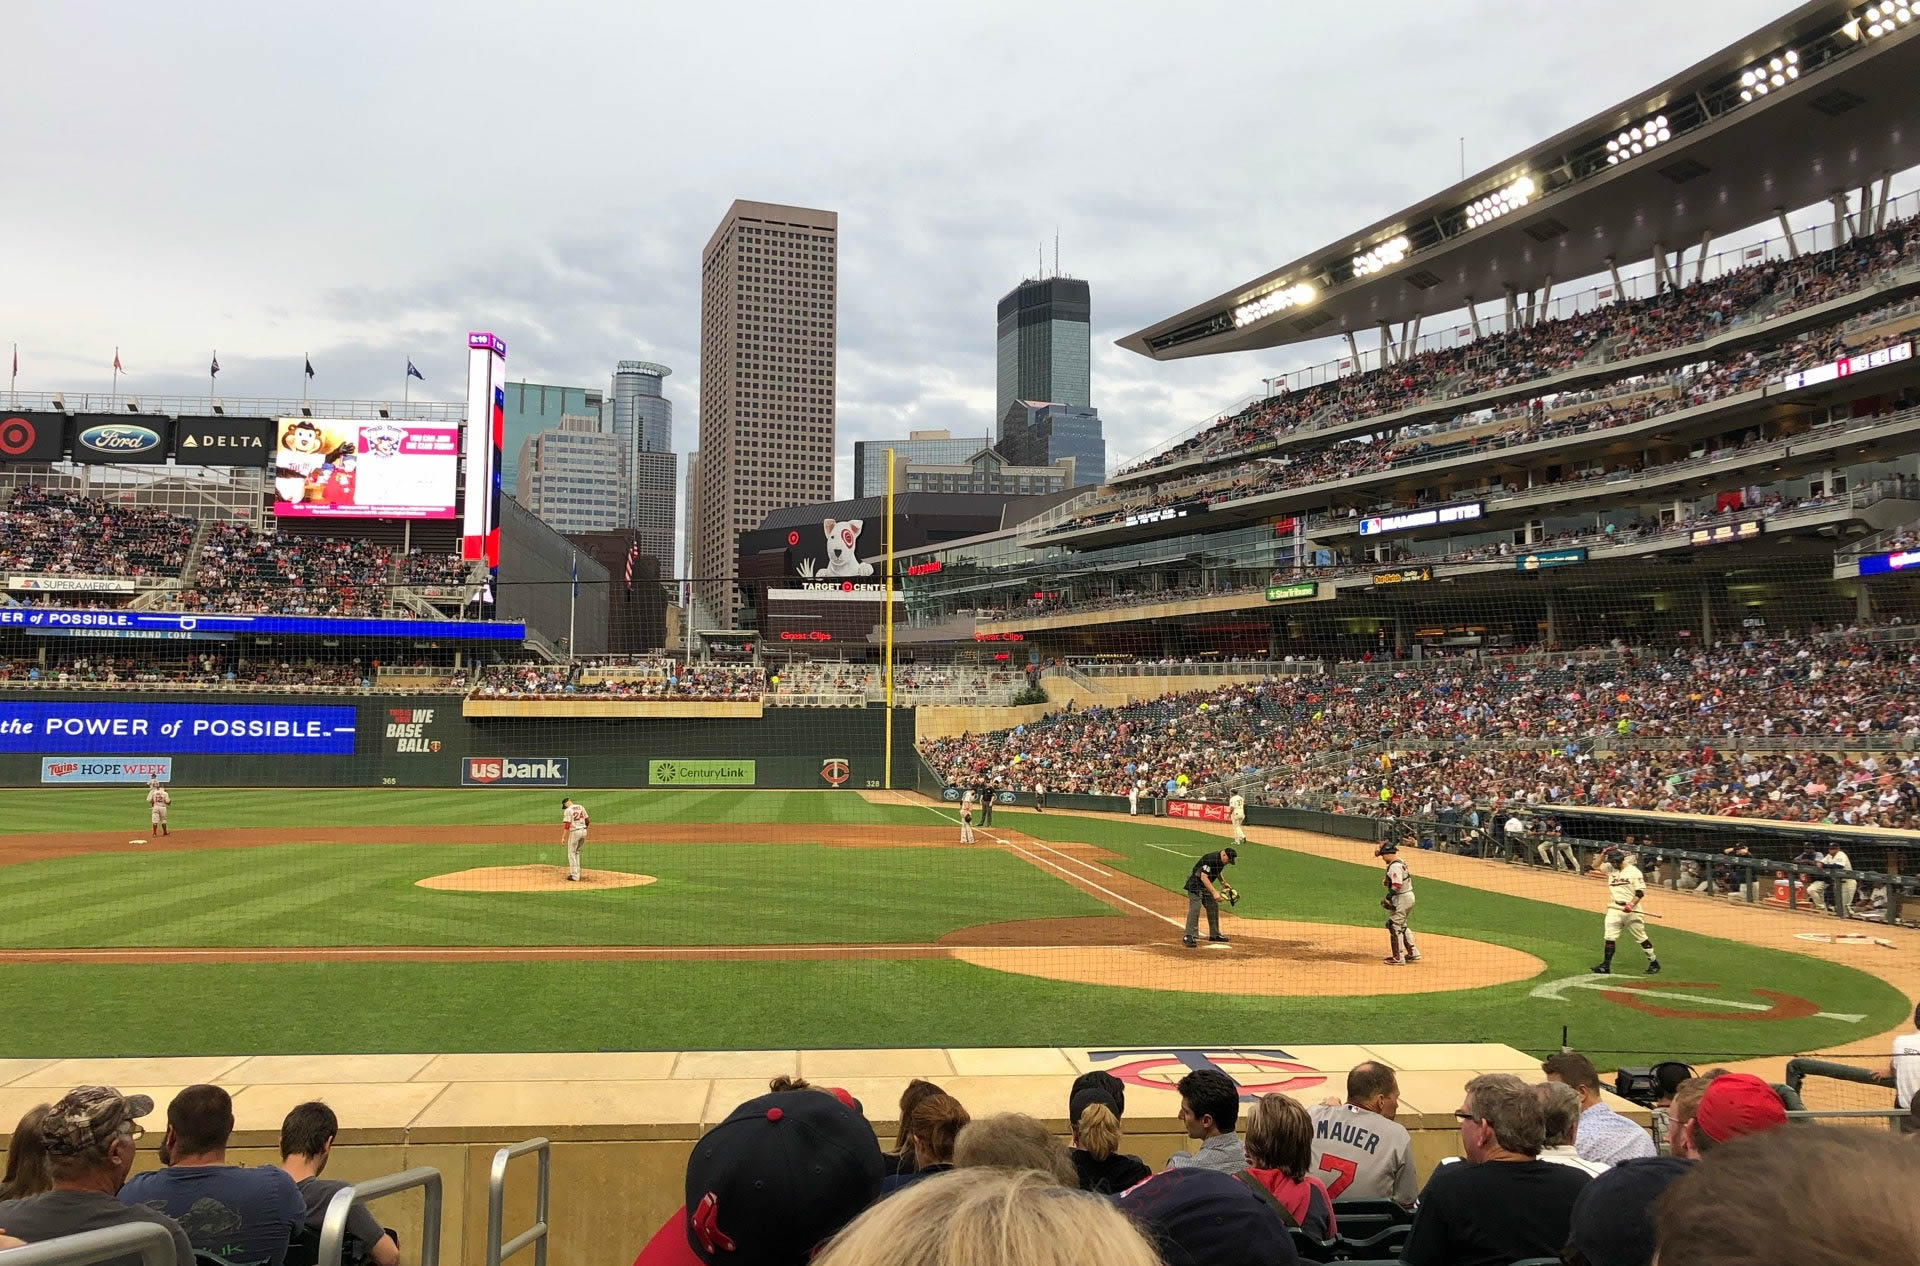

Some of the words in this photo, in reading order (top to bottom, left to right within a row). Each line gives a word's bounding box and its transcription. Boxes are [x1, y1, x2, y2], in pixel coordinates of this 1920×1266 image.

[95, 429, 143, 448] Ford
[203, 436, 263, 448] DELTA
[43, 580, 122, 590] SUPERAMERICA
[802, 583, 841, 591] TARGET
[853, 583, 889, 592] CENTE
[0, 612, 23, 622] ER
[30, 613, 43, 625] of
[1743, 617, 1766, 627] GRILL
[69, 628, 120, 637] TREASURE
[126, 630, 161, 638] ISLAND
[167, 631, 192, 639] COVE
[780, 631, 806, 640] Great
[809, 631, 832, 642] Clips
[973, 632, 999, 641] Great
[1002, 631, 1024, 642] Clips
[412, 708, 434, 723] WE
[0, 718, 33, 735] the
[46, 718, 148, 736] POWER
[160, 719, 183, 738] of
[386, 724, 422, 738] BASE
[397, 738, 430, 752] BALL
[48, 763, 78, 777] Twins
[81, 764, 120, 775] HOPE
[123, 764, 166, 776] WEEK
[680, 767, 745, 780] CenturyLink
[382, 777, 396, 785] 365
[866, 780, 880, 788] 328
[572, 811, 584, 821] 24
[1316, 1120, 1380, 1155] MAUER
[1319, 1152, 1358, 1200] 7
